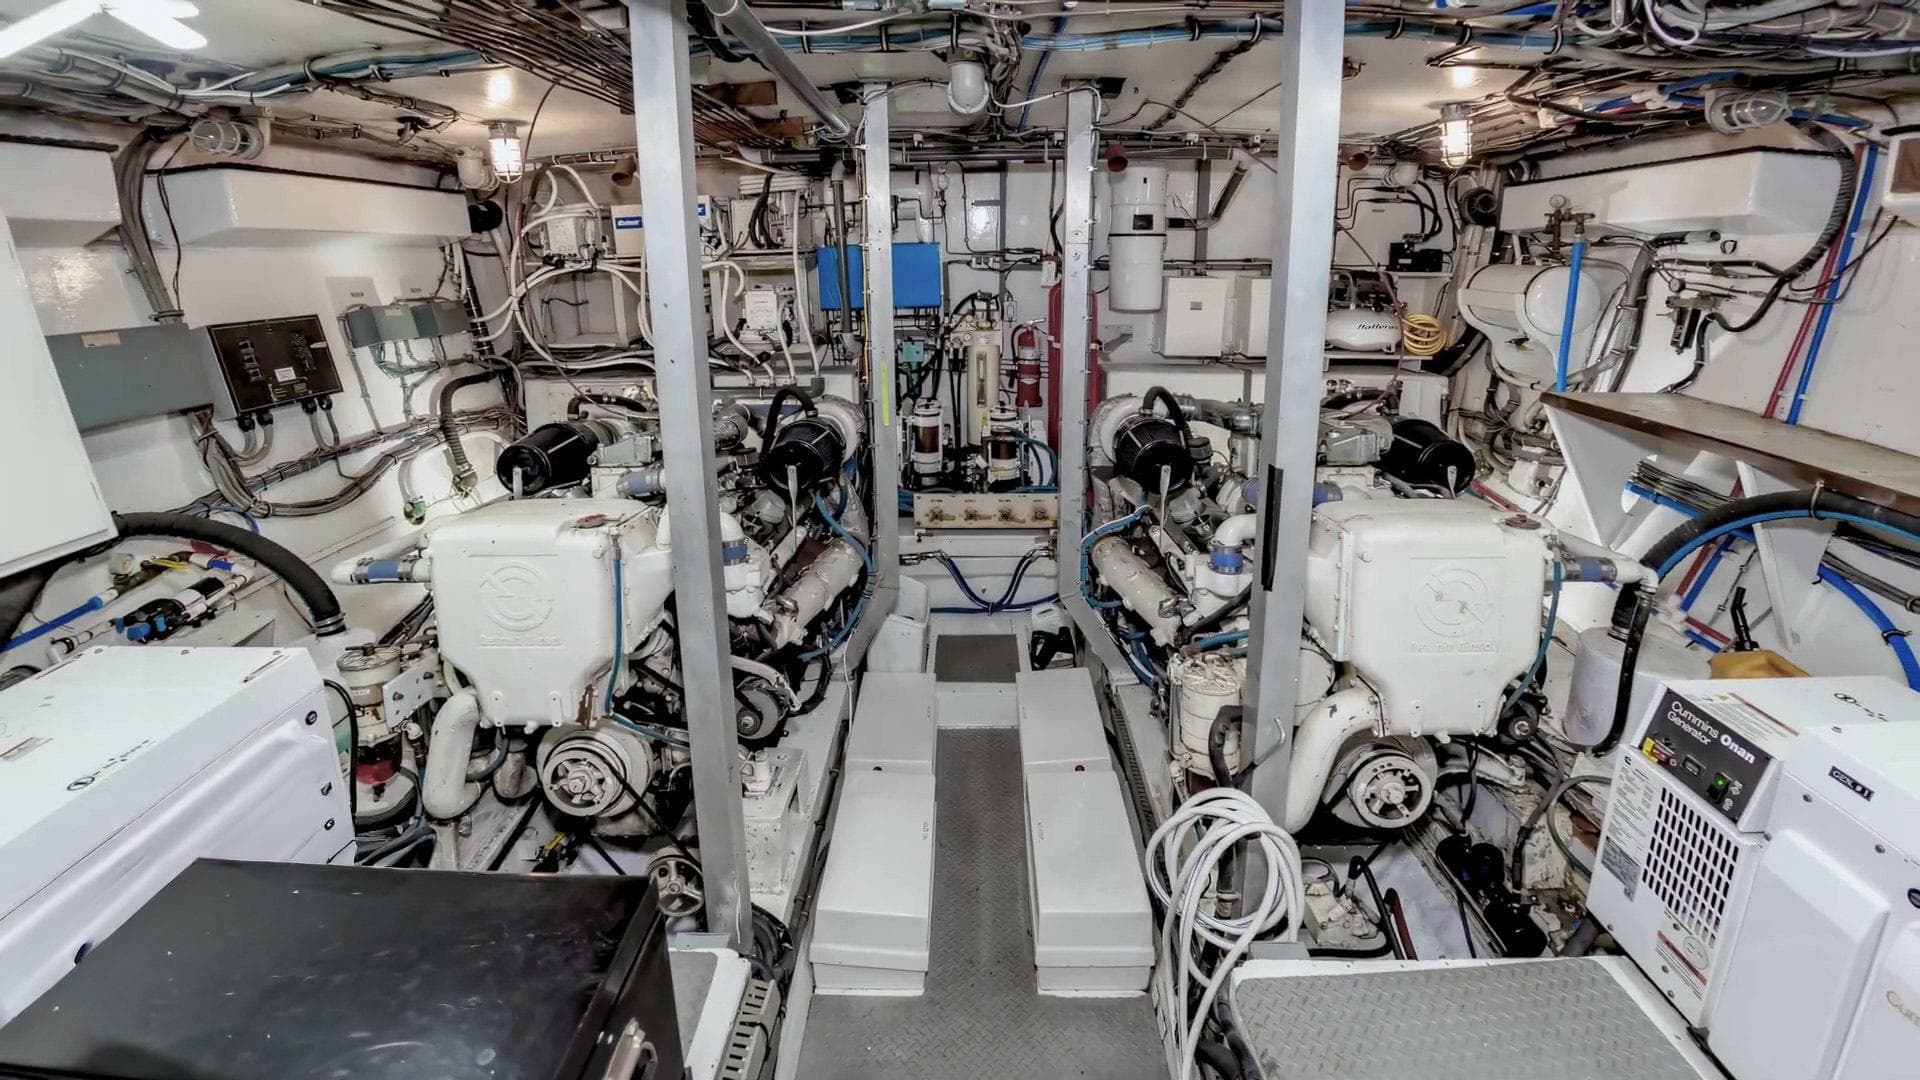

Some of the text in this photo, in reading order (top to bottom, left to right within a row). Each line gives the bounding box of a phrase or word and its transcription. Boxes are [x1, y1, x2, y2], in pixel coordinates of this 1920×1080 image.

[1667, 710, 1711, 745] Generator
[1671, 700, 1719, 739] Cummins
[1720, 733, 1755, 764] Onan
